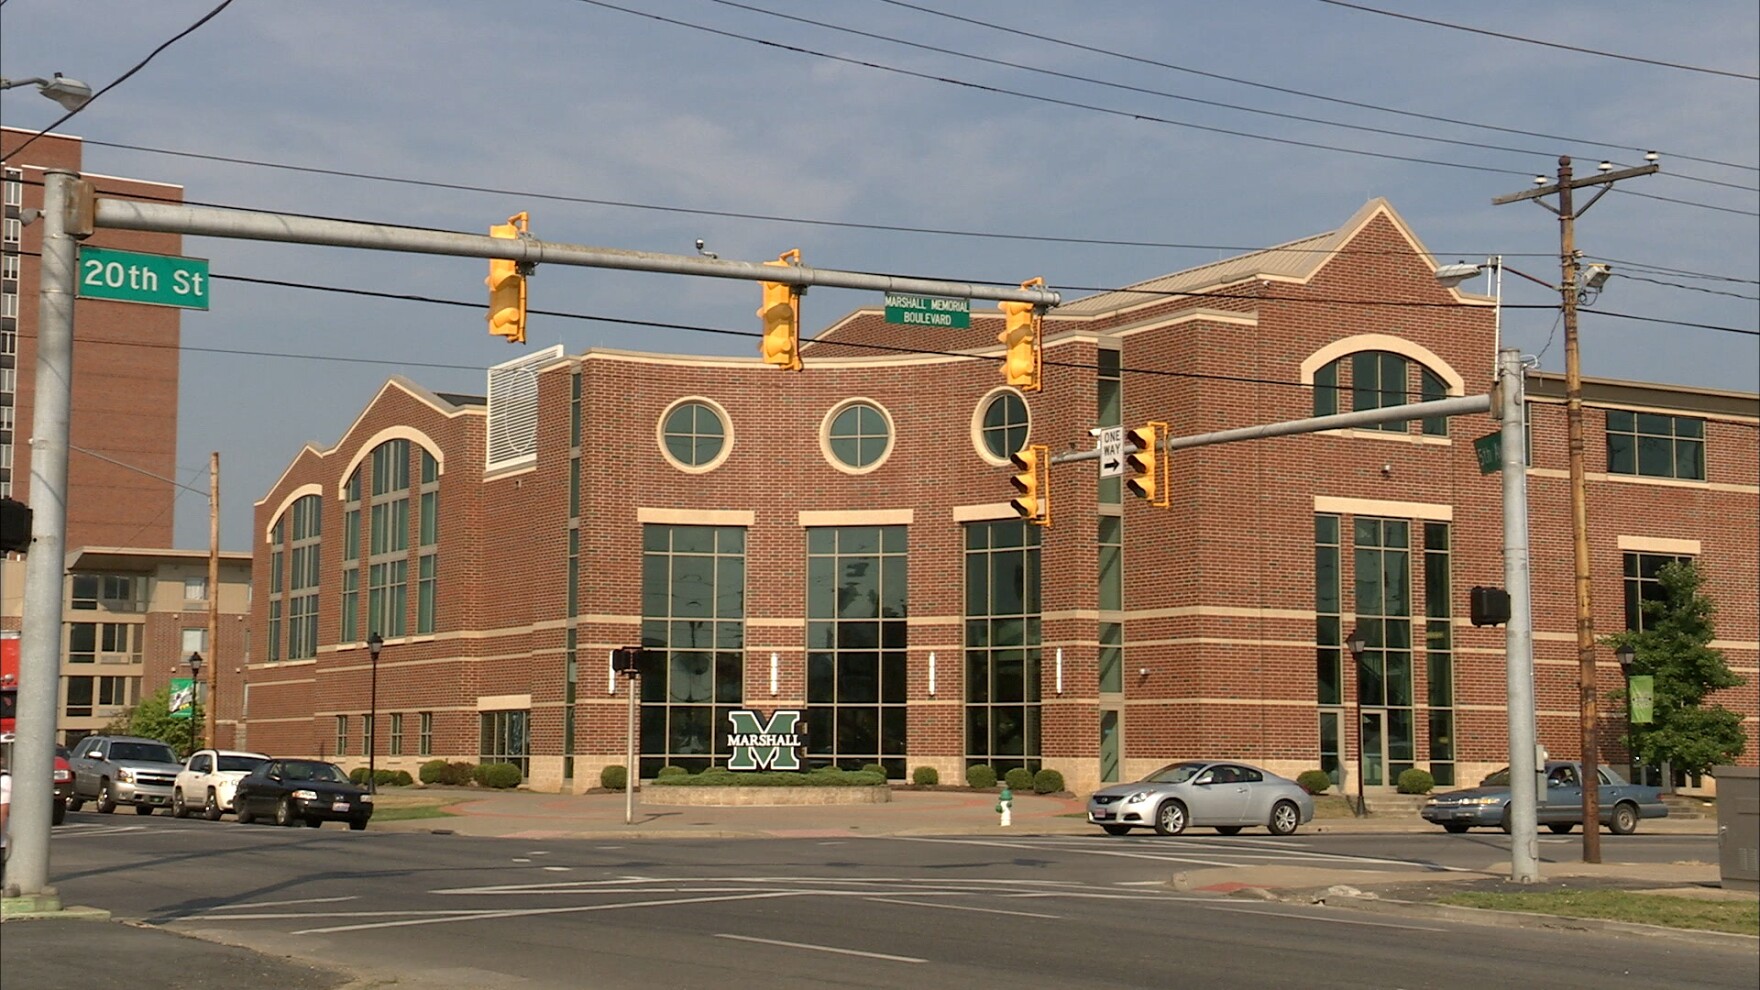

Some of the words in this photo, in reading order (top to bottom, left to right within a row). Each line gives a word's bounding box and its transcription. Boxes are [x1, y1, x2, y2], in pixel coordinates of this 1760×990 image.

[84, 259, 158, 292] 20th
[172, 269, 204, 297] St
[885, 296, 927, 310] MARSHALL
[930, 299, 970, 313] MEMORIAL
[903, 311, 952, 326] BOULEVARD
[1104, 430, 1120, 443] ONE
[1104, 443, 1120, 456] WAY
[727, 734, 801, 747] MARSHALL
